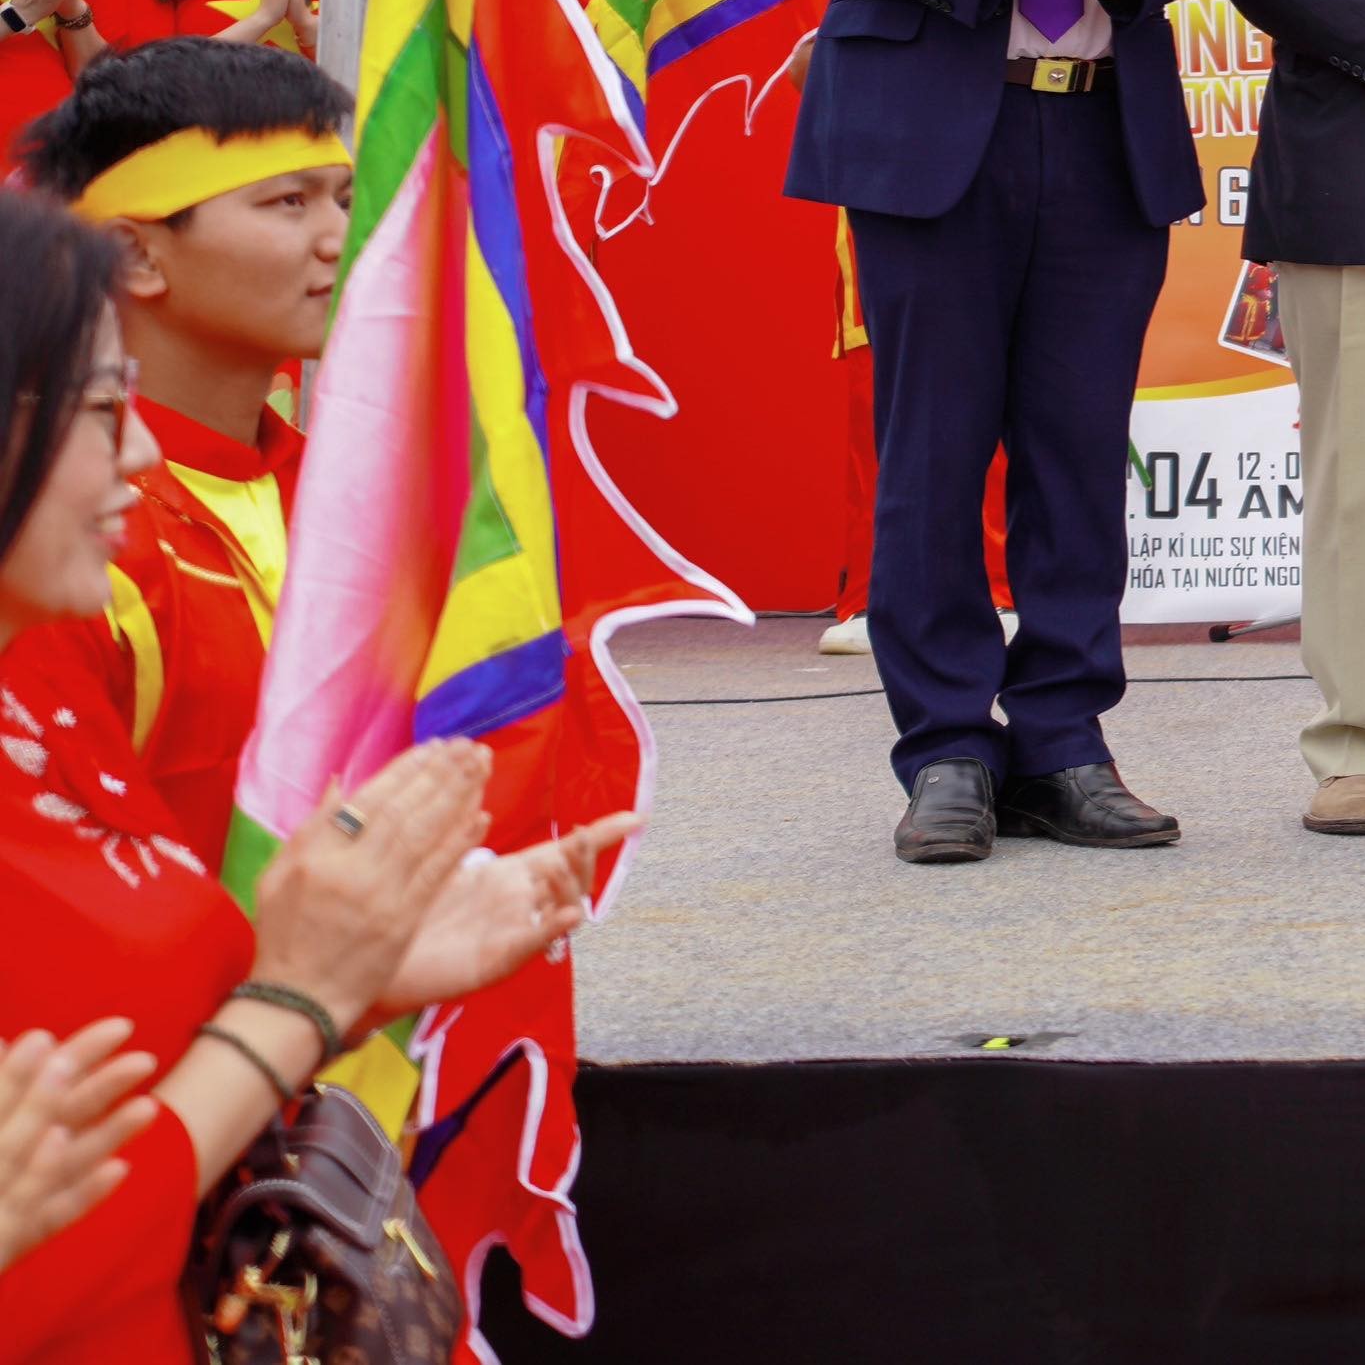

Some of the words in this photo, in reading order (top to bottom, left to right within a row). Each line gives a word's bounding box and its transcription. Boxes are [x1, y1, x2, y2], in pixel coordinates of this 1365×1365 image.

[1130, 533, 1162, 561] LẬP
[1168, 532, 1184, 558] KỈ
[1191, 537, 1224, 561] LỤC
[1230, 536, 1256, 560] SỰ
[1262, 532, 1300, 560] KIỆN
[1130, 564, 1165, 589] HÓA
[1172, 568, 1198, 592] TẠI
[1205, 563, 1258, 588] NƯỚC
